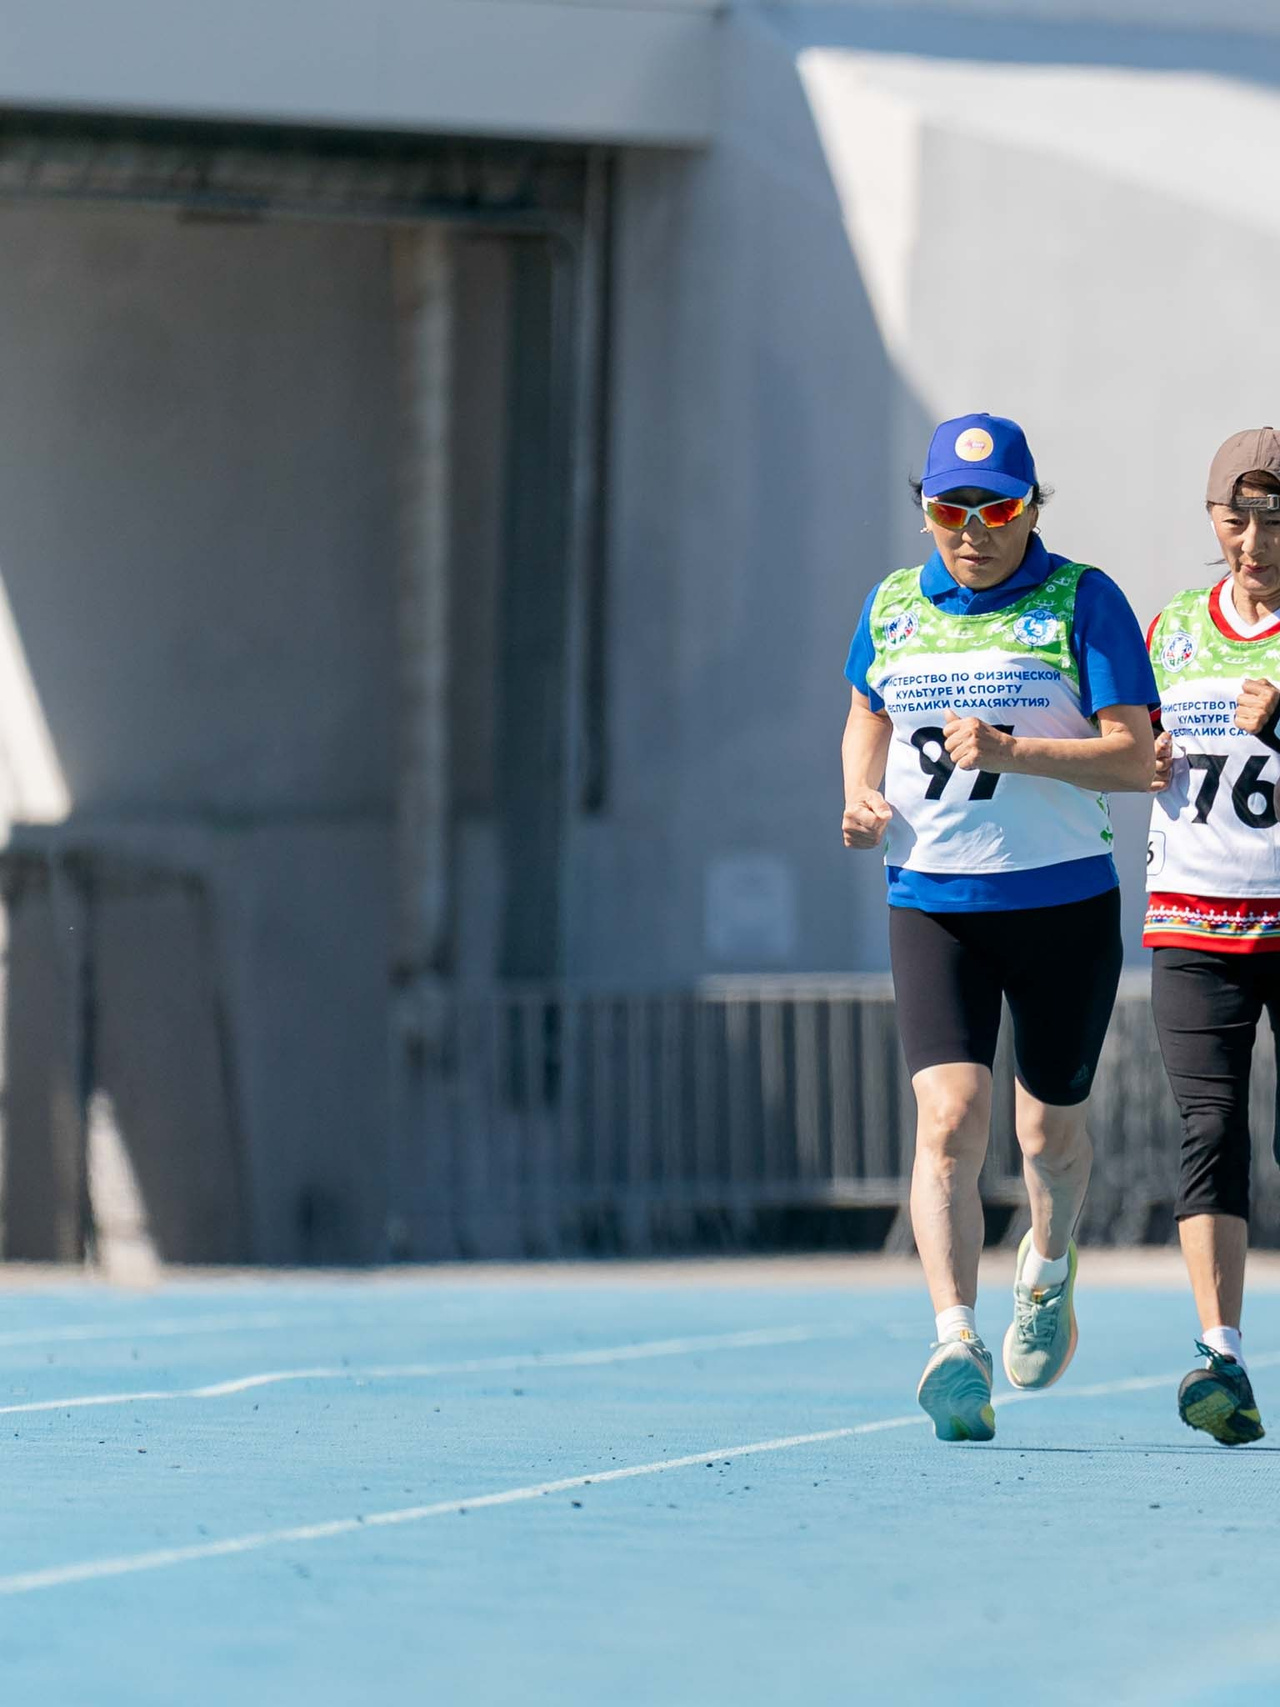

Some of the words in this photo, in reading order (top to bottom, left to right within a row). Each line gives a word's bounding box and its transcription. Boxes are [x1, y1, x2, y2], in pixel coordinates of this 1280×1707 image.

[951, 672, 970, 682] ПО
[973, 670, 1061, 681] ФИЗИЧЕСКОЙ
[895, 685, 956, 700] КУЛЬТУРЕ
[956, 685, 966, 695] И
[968, 684, 1023, 695] СПОРТУ
[887, 699, 951, 714] ЕСПУБЛИКИ
[953, 697, 1051, 709] САХА(ЯКУТИЯ)
[1229, 701, 1238, 710] П
[1177, 713, 1230, 725] КУЛЬТУРЕ
[1186, 753, 1280, 829] 76
